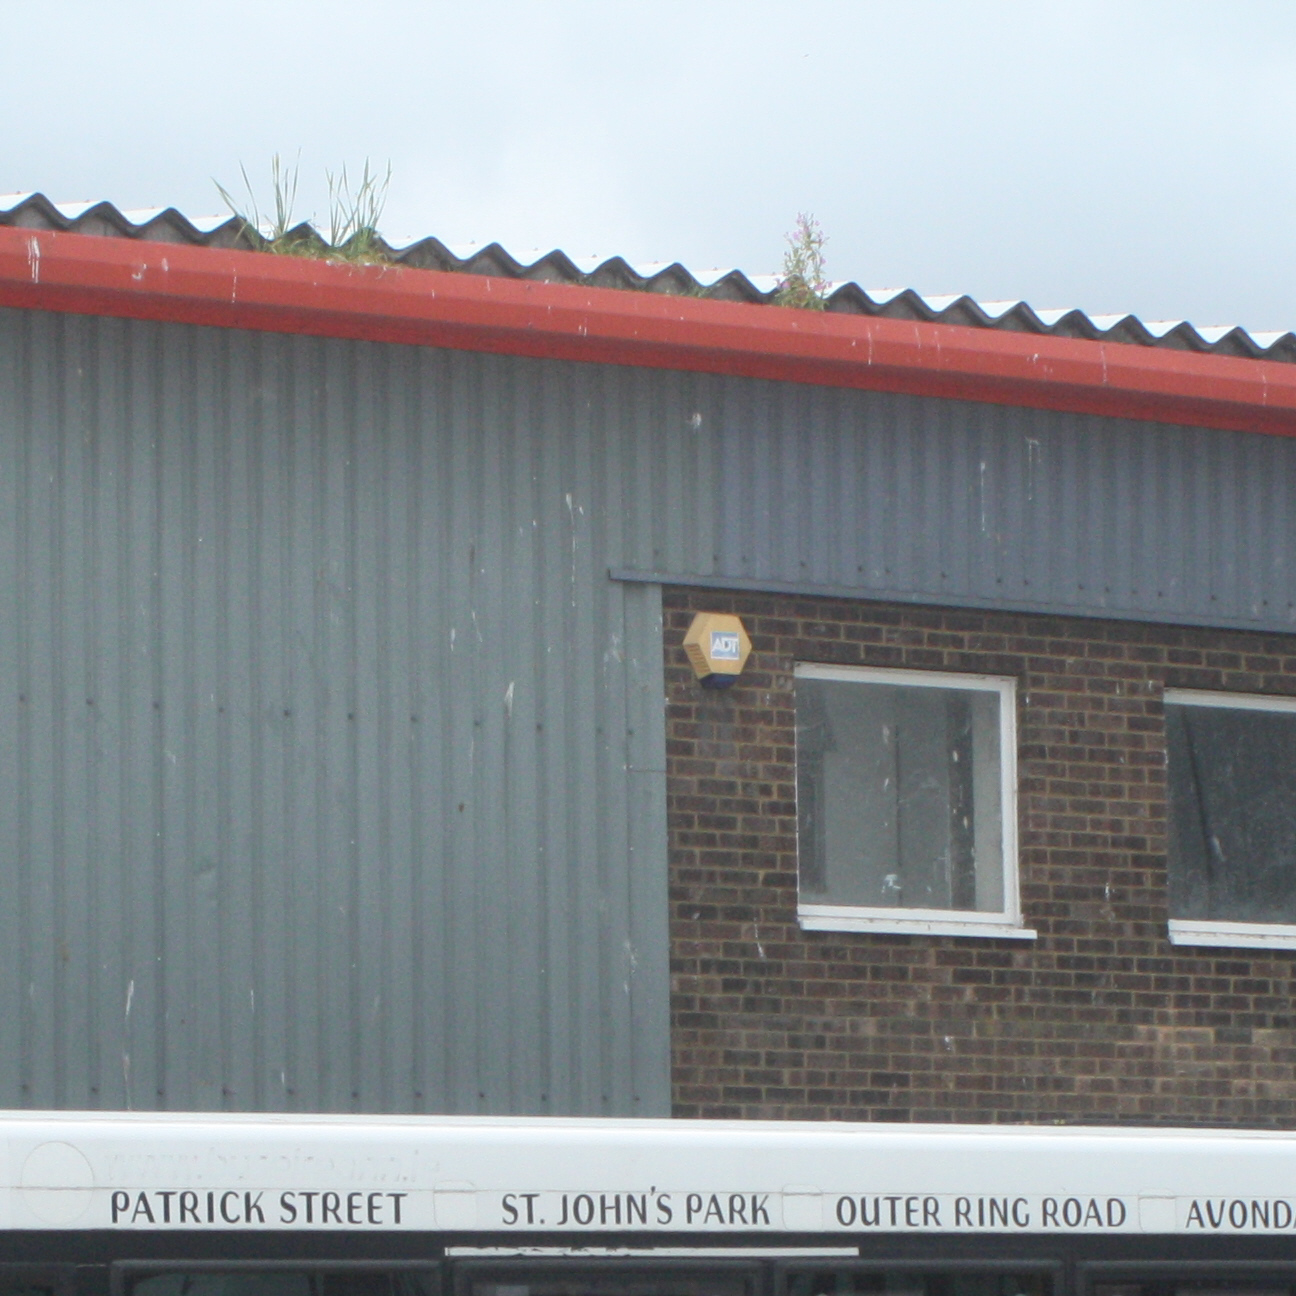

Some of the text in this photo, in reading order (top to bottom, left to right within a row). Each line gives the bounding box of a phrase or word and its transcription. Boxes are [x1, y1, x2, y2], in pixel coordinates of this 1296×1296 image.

[712, 636, 739, 653] ADT
[110, 1190, 409, 1225] PATRICK STREET
[501, 1186, 771, 1226] ST. JOHN'S PARK
[836, 1195, 1127, 1228] OUTER RING ROAD
